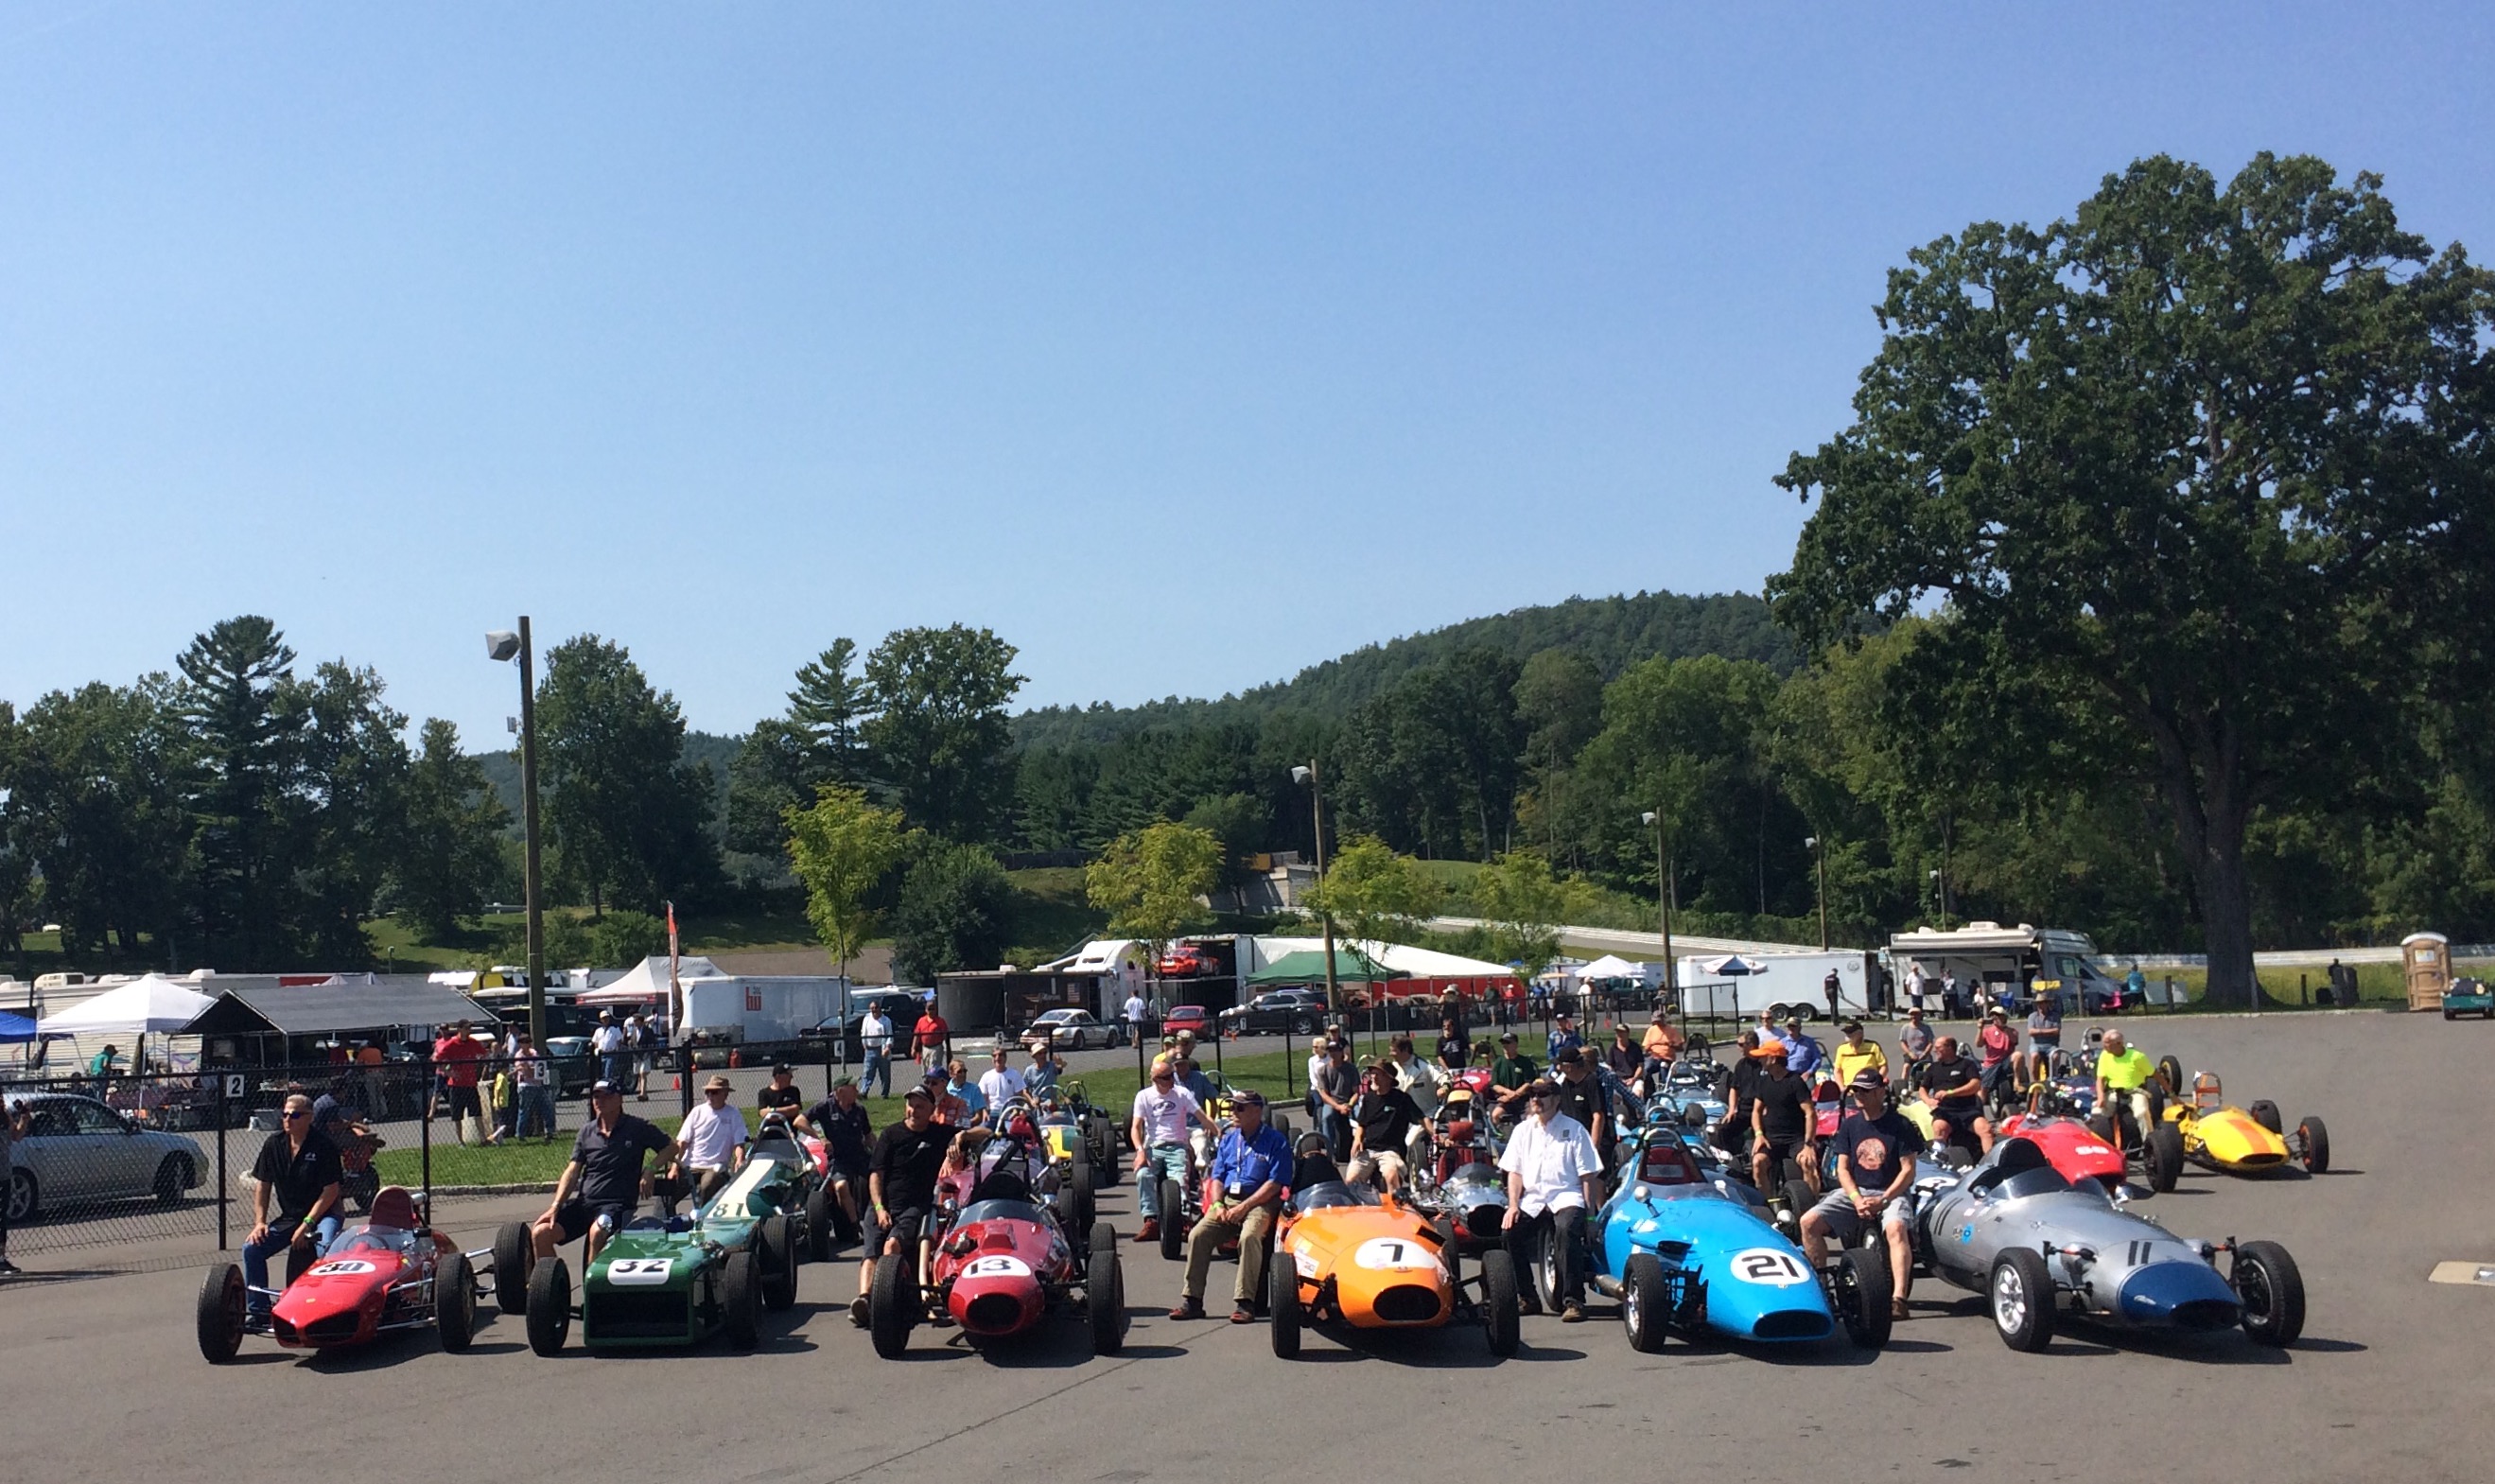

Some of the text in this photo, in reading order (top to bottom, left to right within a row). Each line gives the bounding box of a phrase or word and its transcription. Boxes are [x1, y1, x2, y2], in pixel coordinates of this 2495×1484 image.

[538, 1062, 545, 1077] 3
[231, 1076, 241, 1094] 2
[713, 1202, 745, 1217] 81
[1380, 1243, 1405, 1263] 7
[2127, 1240, 2153, 1267] 11
[318, 1262, 367, 1274] 30
[615, 1260, 667, 1274] 32
[969, 1258, 1012, 1275] 13
[1741, 1255, 1801, 1279] 21
